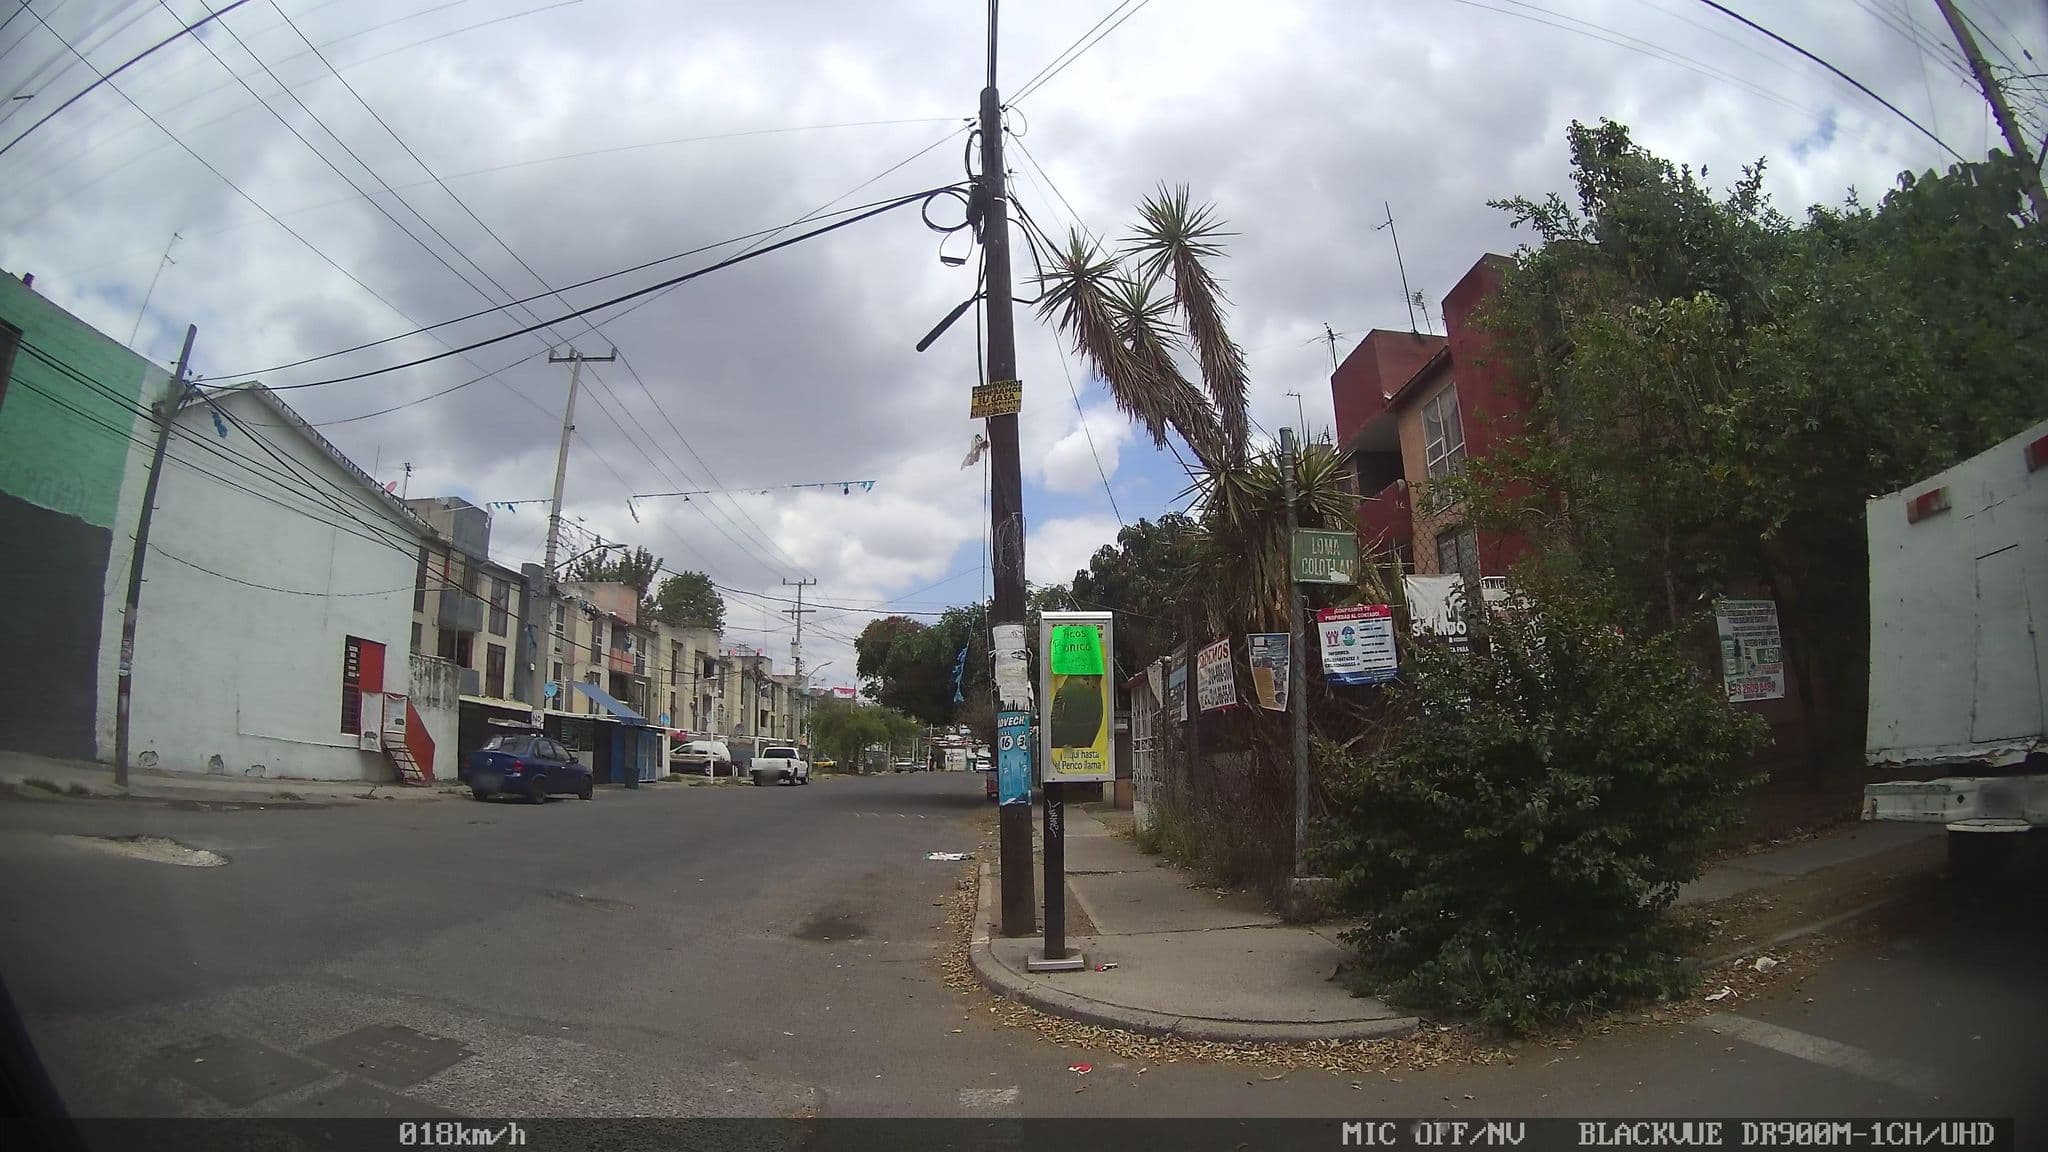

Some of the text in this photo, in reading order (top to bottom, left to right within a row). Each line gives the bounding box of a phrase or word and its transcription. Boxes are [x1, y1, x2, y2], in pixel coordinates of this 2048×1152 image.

[1311, 537, 1340, 556] LOMA
[1001, 737, 1010, 748] 16
[1062, 761, 1082, 770] Penco
